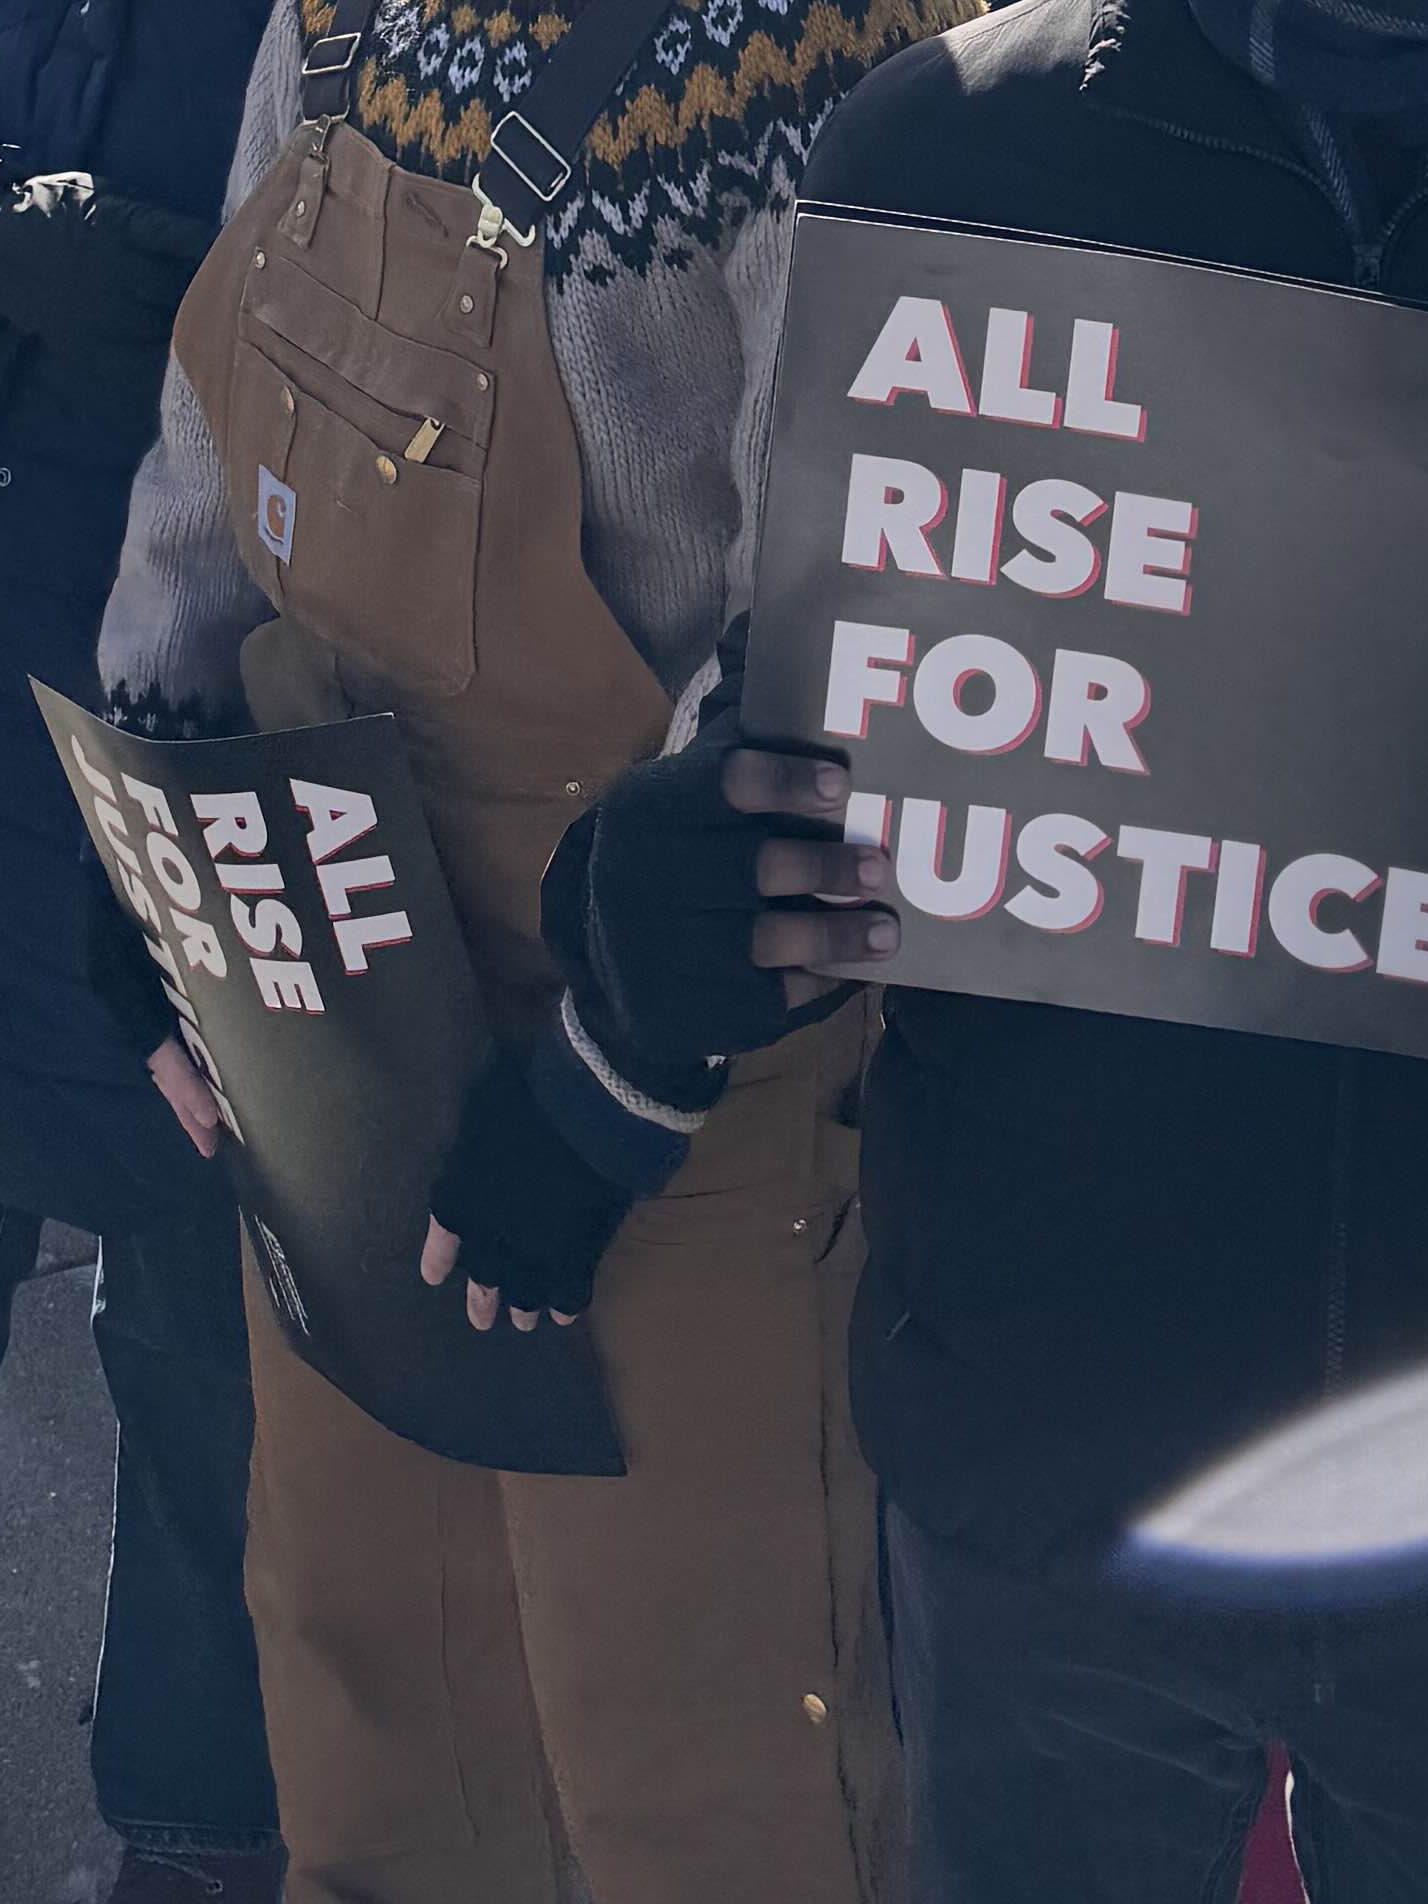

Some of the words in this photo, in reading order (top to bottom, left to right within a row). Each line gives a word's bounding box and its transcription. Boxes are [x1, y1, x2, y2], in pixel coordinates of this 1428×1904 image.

[847, 295, 1147, 443] ALL
[840, 452, 1199, 616] RISE
[824, 619, 1151, 776] FOR
[71, 735, 245, 1145] JUSTICE
[121, 772, 228, 980] FOR
[190, 791, 325, 1016] RISE
[289, 777, 413, 977] ALL
